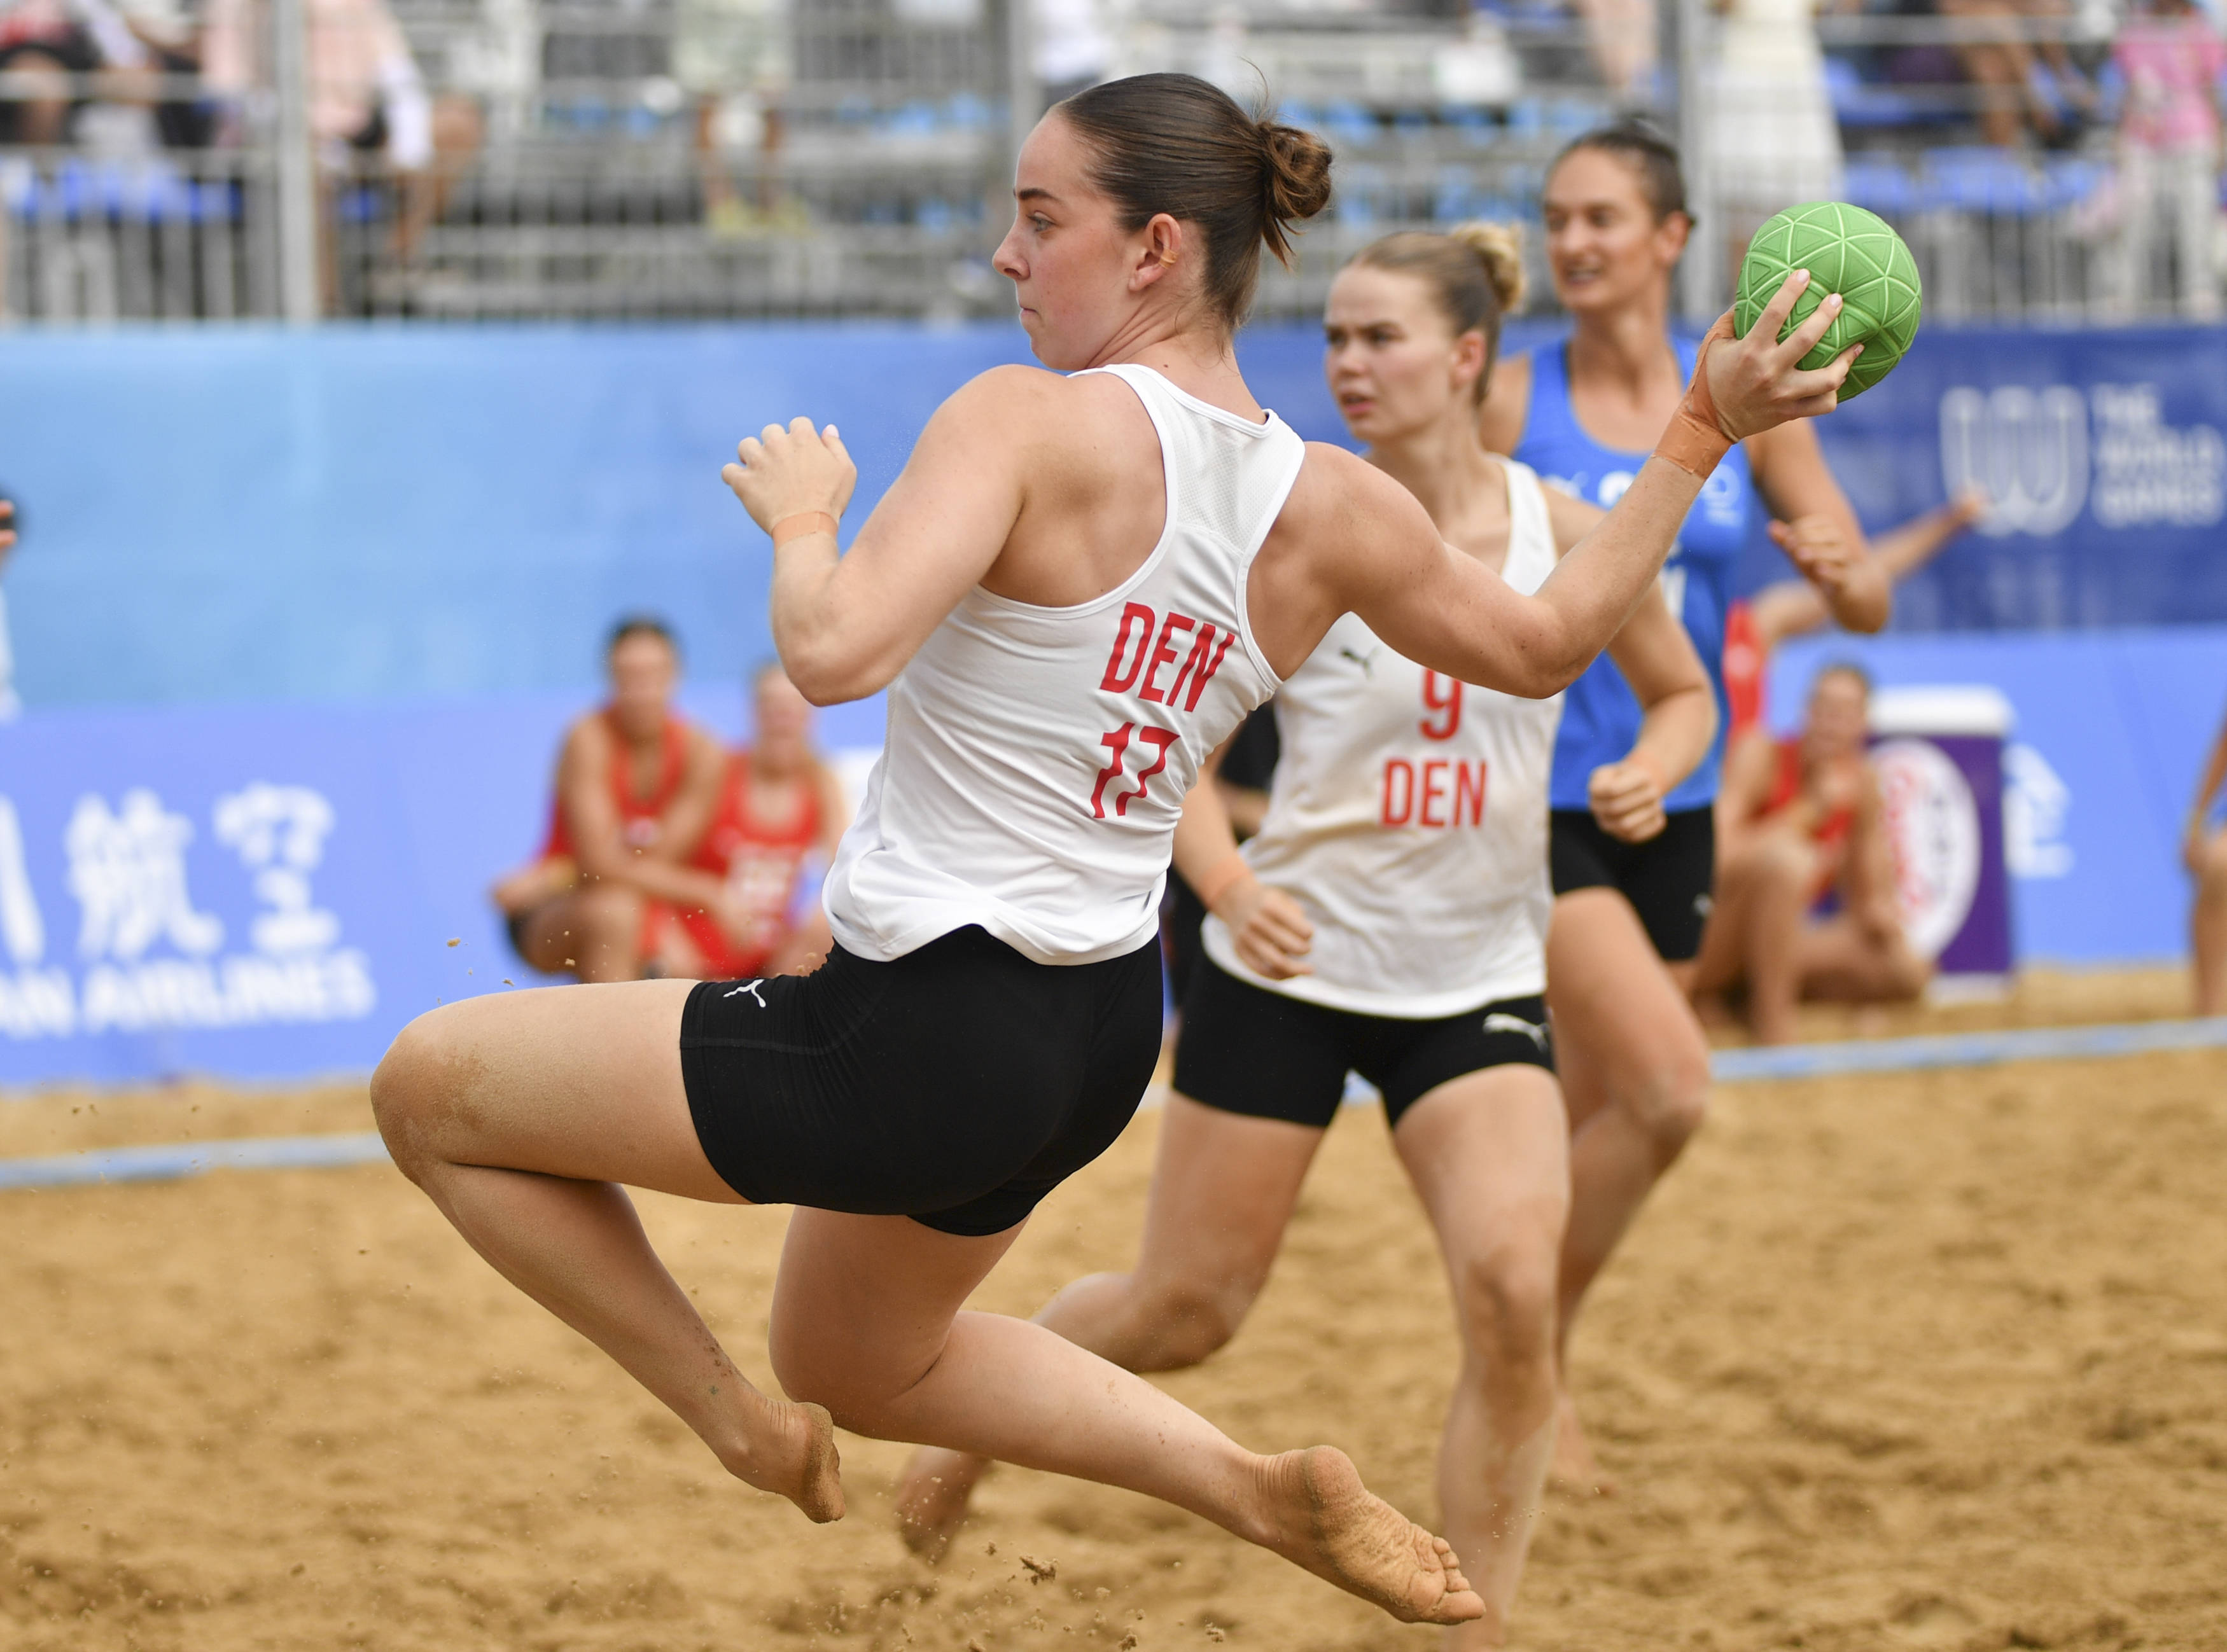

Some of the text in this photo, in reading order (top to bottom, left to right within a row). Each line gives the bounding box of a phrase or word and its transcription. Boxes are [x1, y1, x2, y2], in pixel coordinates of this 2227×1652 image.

[1100, 602, 1235, 712] DEN
[1419, 667, 1463, 742] 9
[1091, 721, 1180, 818] 17
[1381, 758, 1487, 828] DEN
[0, 787, 337, 958] 航空
[83, 951, 374, 1033] AIRLINES
